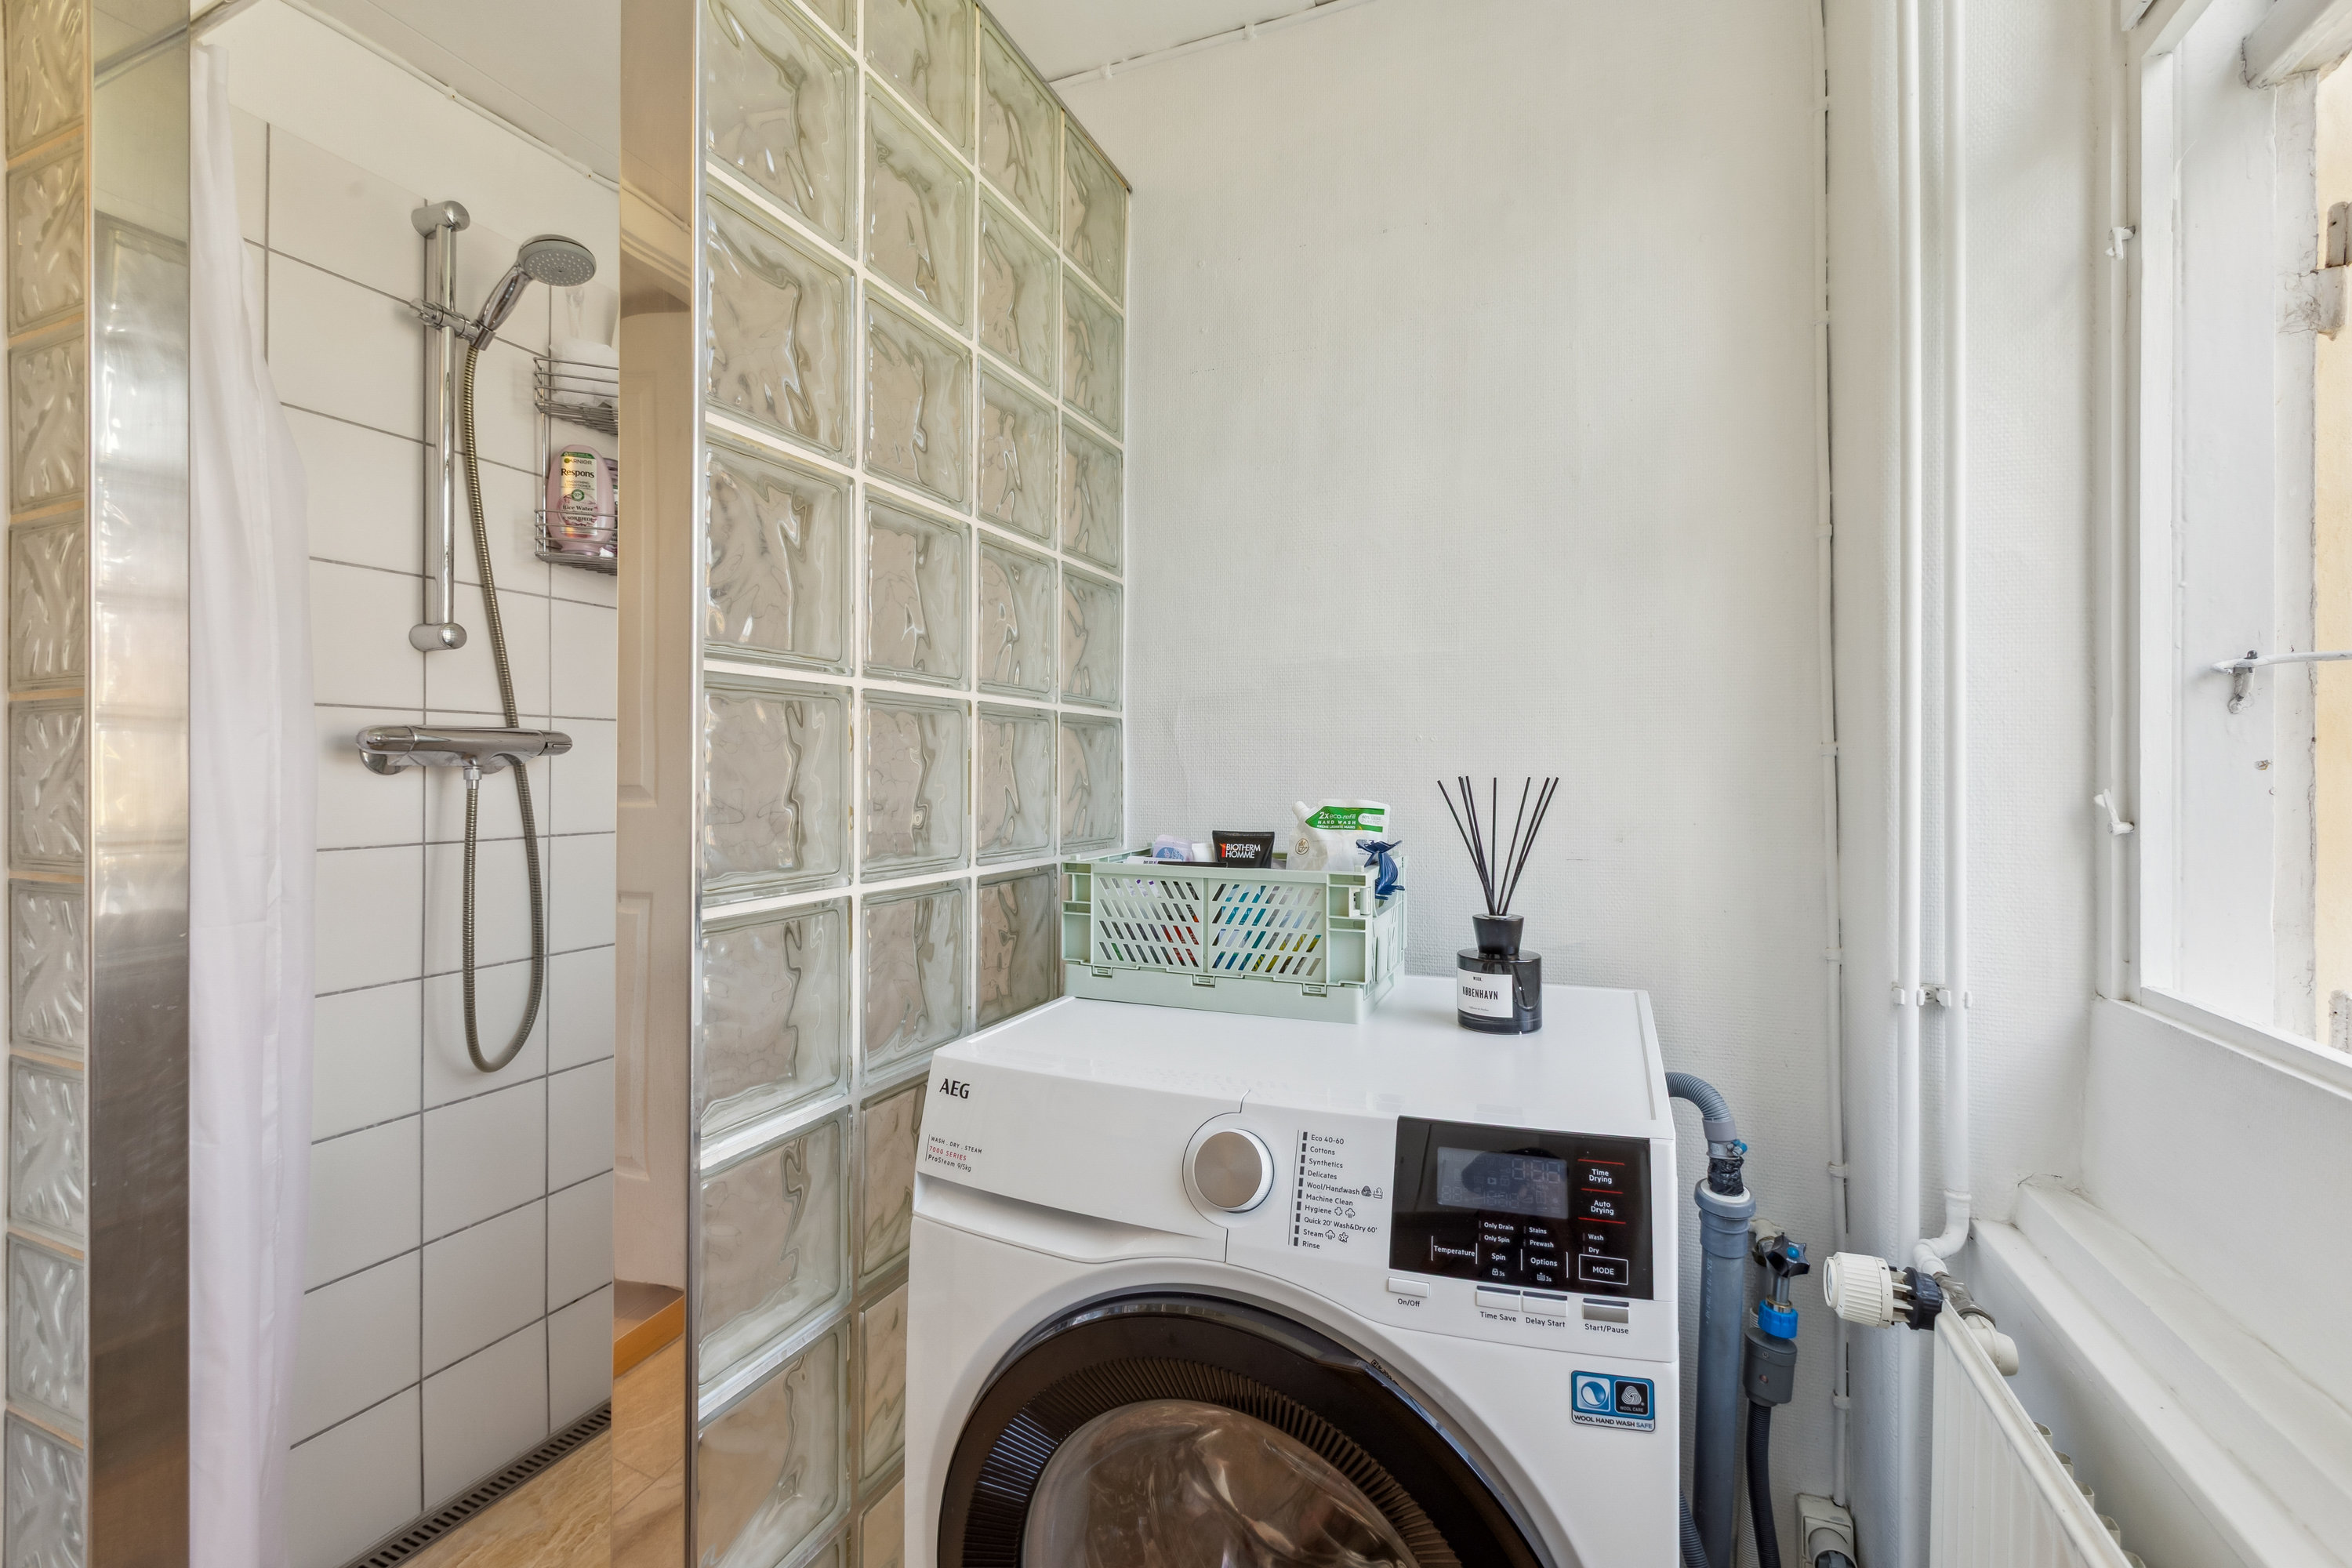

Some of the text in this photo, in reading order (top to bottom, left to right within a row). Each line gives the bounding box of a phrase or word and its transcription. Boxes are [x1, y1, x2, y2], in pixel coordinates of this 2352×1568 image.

[561, 468, 594, 478] Respons
[1226, 844, 1261, 852] BIOTHERM
[939, 1078, 970, 1099] AEG
[931, 1136, 945, 1145] WASH
[964, 1145, 982, 1154] STEAM
[928, 1145, 967, 1161] 7000 SERIES
[1310, 1146, 1335, 1155] Cottons
[927, 1154, 971, 1173] ProSteam 9/5kg
[1309, 1158, 1343, 1169] Synthetics
[1308, 1170, 1338, 1180] Delicates
[1592, 1168, 1609, 1177] Time
[1589, 1174, 1612, 1184] Drying
[1307, 1181, 1360, 1195] Wool/Handwash
[1306, 1193, 1333, 1203] Machine
[1305, 1205, 1332, 1214] Hygiene
[1591, 1206, 1614, 1215] Drying
[1304, 1217, 1321, 1225] Quick
[1334, 1221, 1366, 1232] Wash&Dry
[1303, 1229, 1323, 1238] Steam
[1302, 1241, 1320, 1250] Rinse
[1530, 1240, 1554, 1248] Prewash
[1434, 1245, 1475, 1257] Temperature
[1491, 1253, 1506, 1261] Spin
[1530, 1257, 1558, 1267] Options
[1592, 1266, 1614, 1276] MODE
[1397, 1298, 1420, 1308] On/Off
[1480, 1311, 1517, 1323] Time Save
[1526, 1316, 1545, 1327] Delay
[1584, 1323, 1629, 1334] Start/Pause
[1574, 1414, 1595, 1423] WOOL
